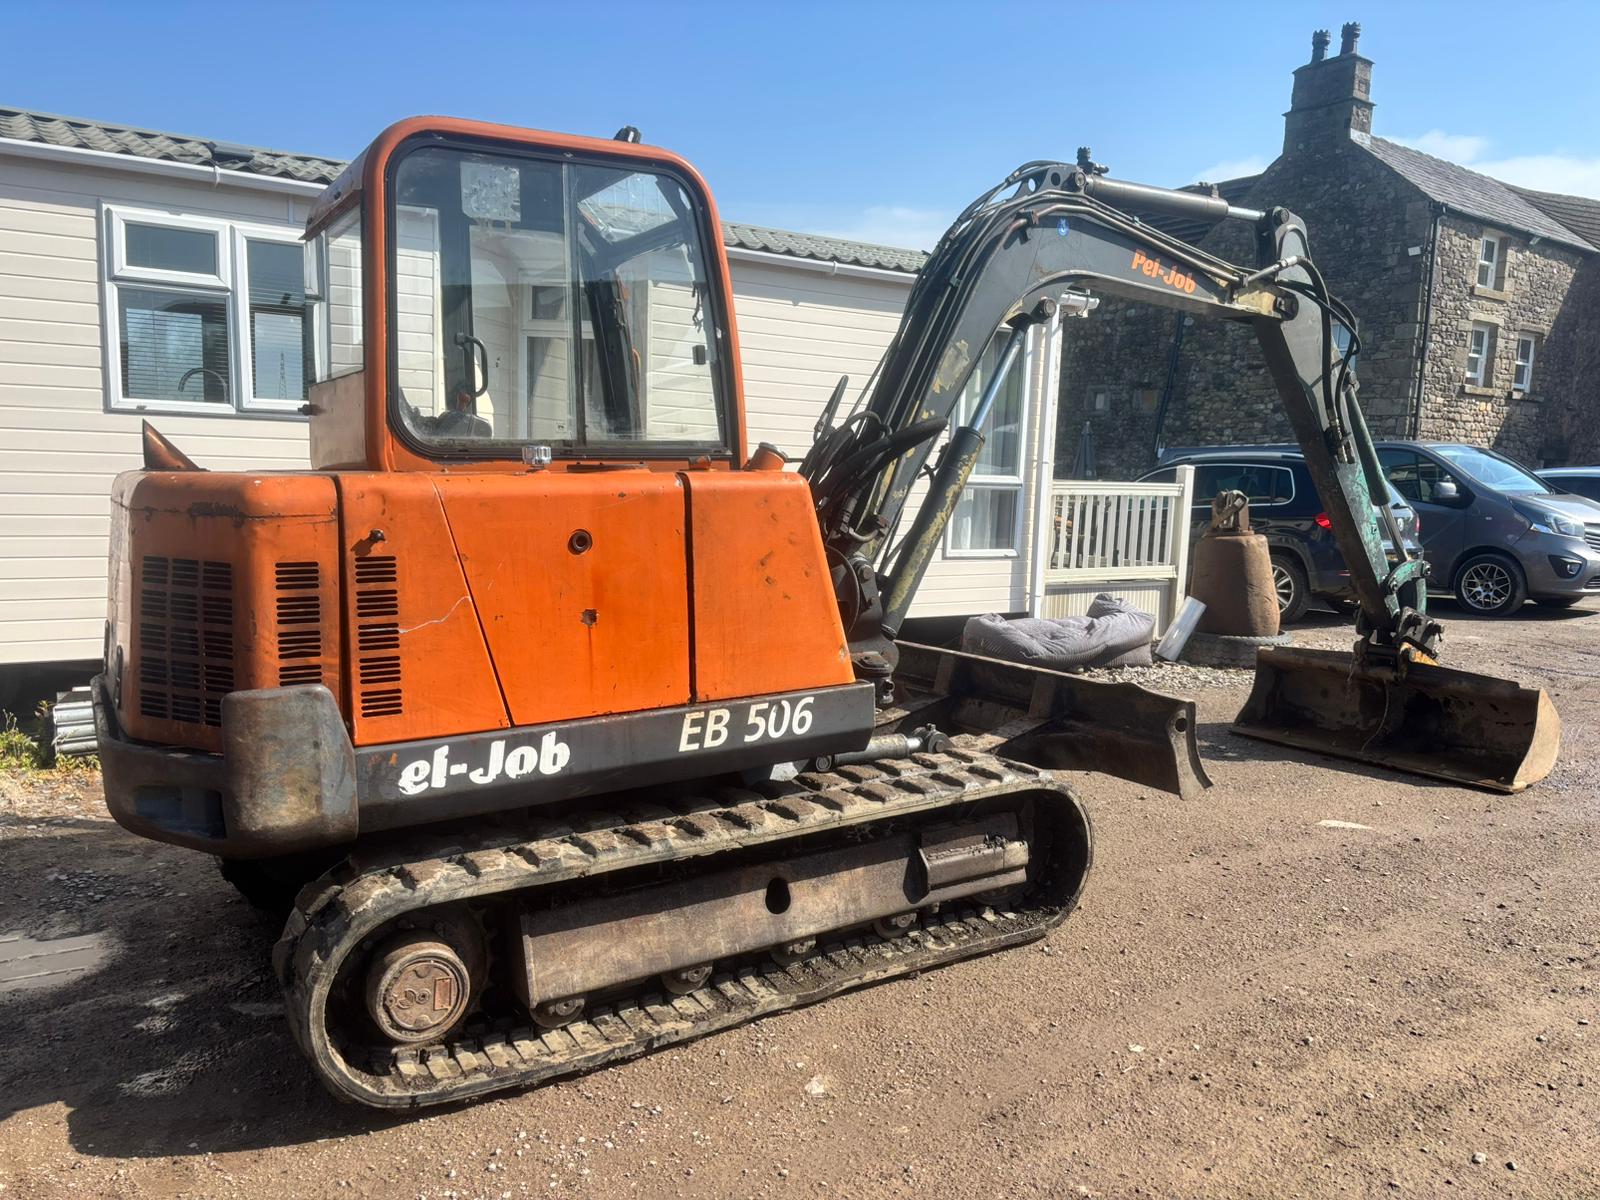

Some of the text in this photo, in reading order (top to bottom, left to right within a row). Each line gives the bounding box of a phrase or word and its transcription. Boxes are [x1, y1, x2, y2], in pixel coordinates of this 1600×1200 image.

[1131, 249, 1196, 293] Pel-Job
[679, 696, 814, 752] EB 506
